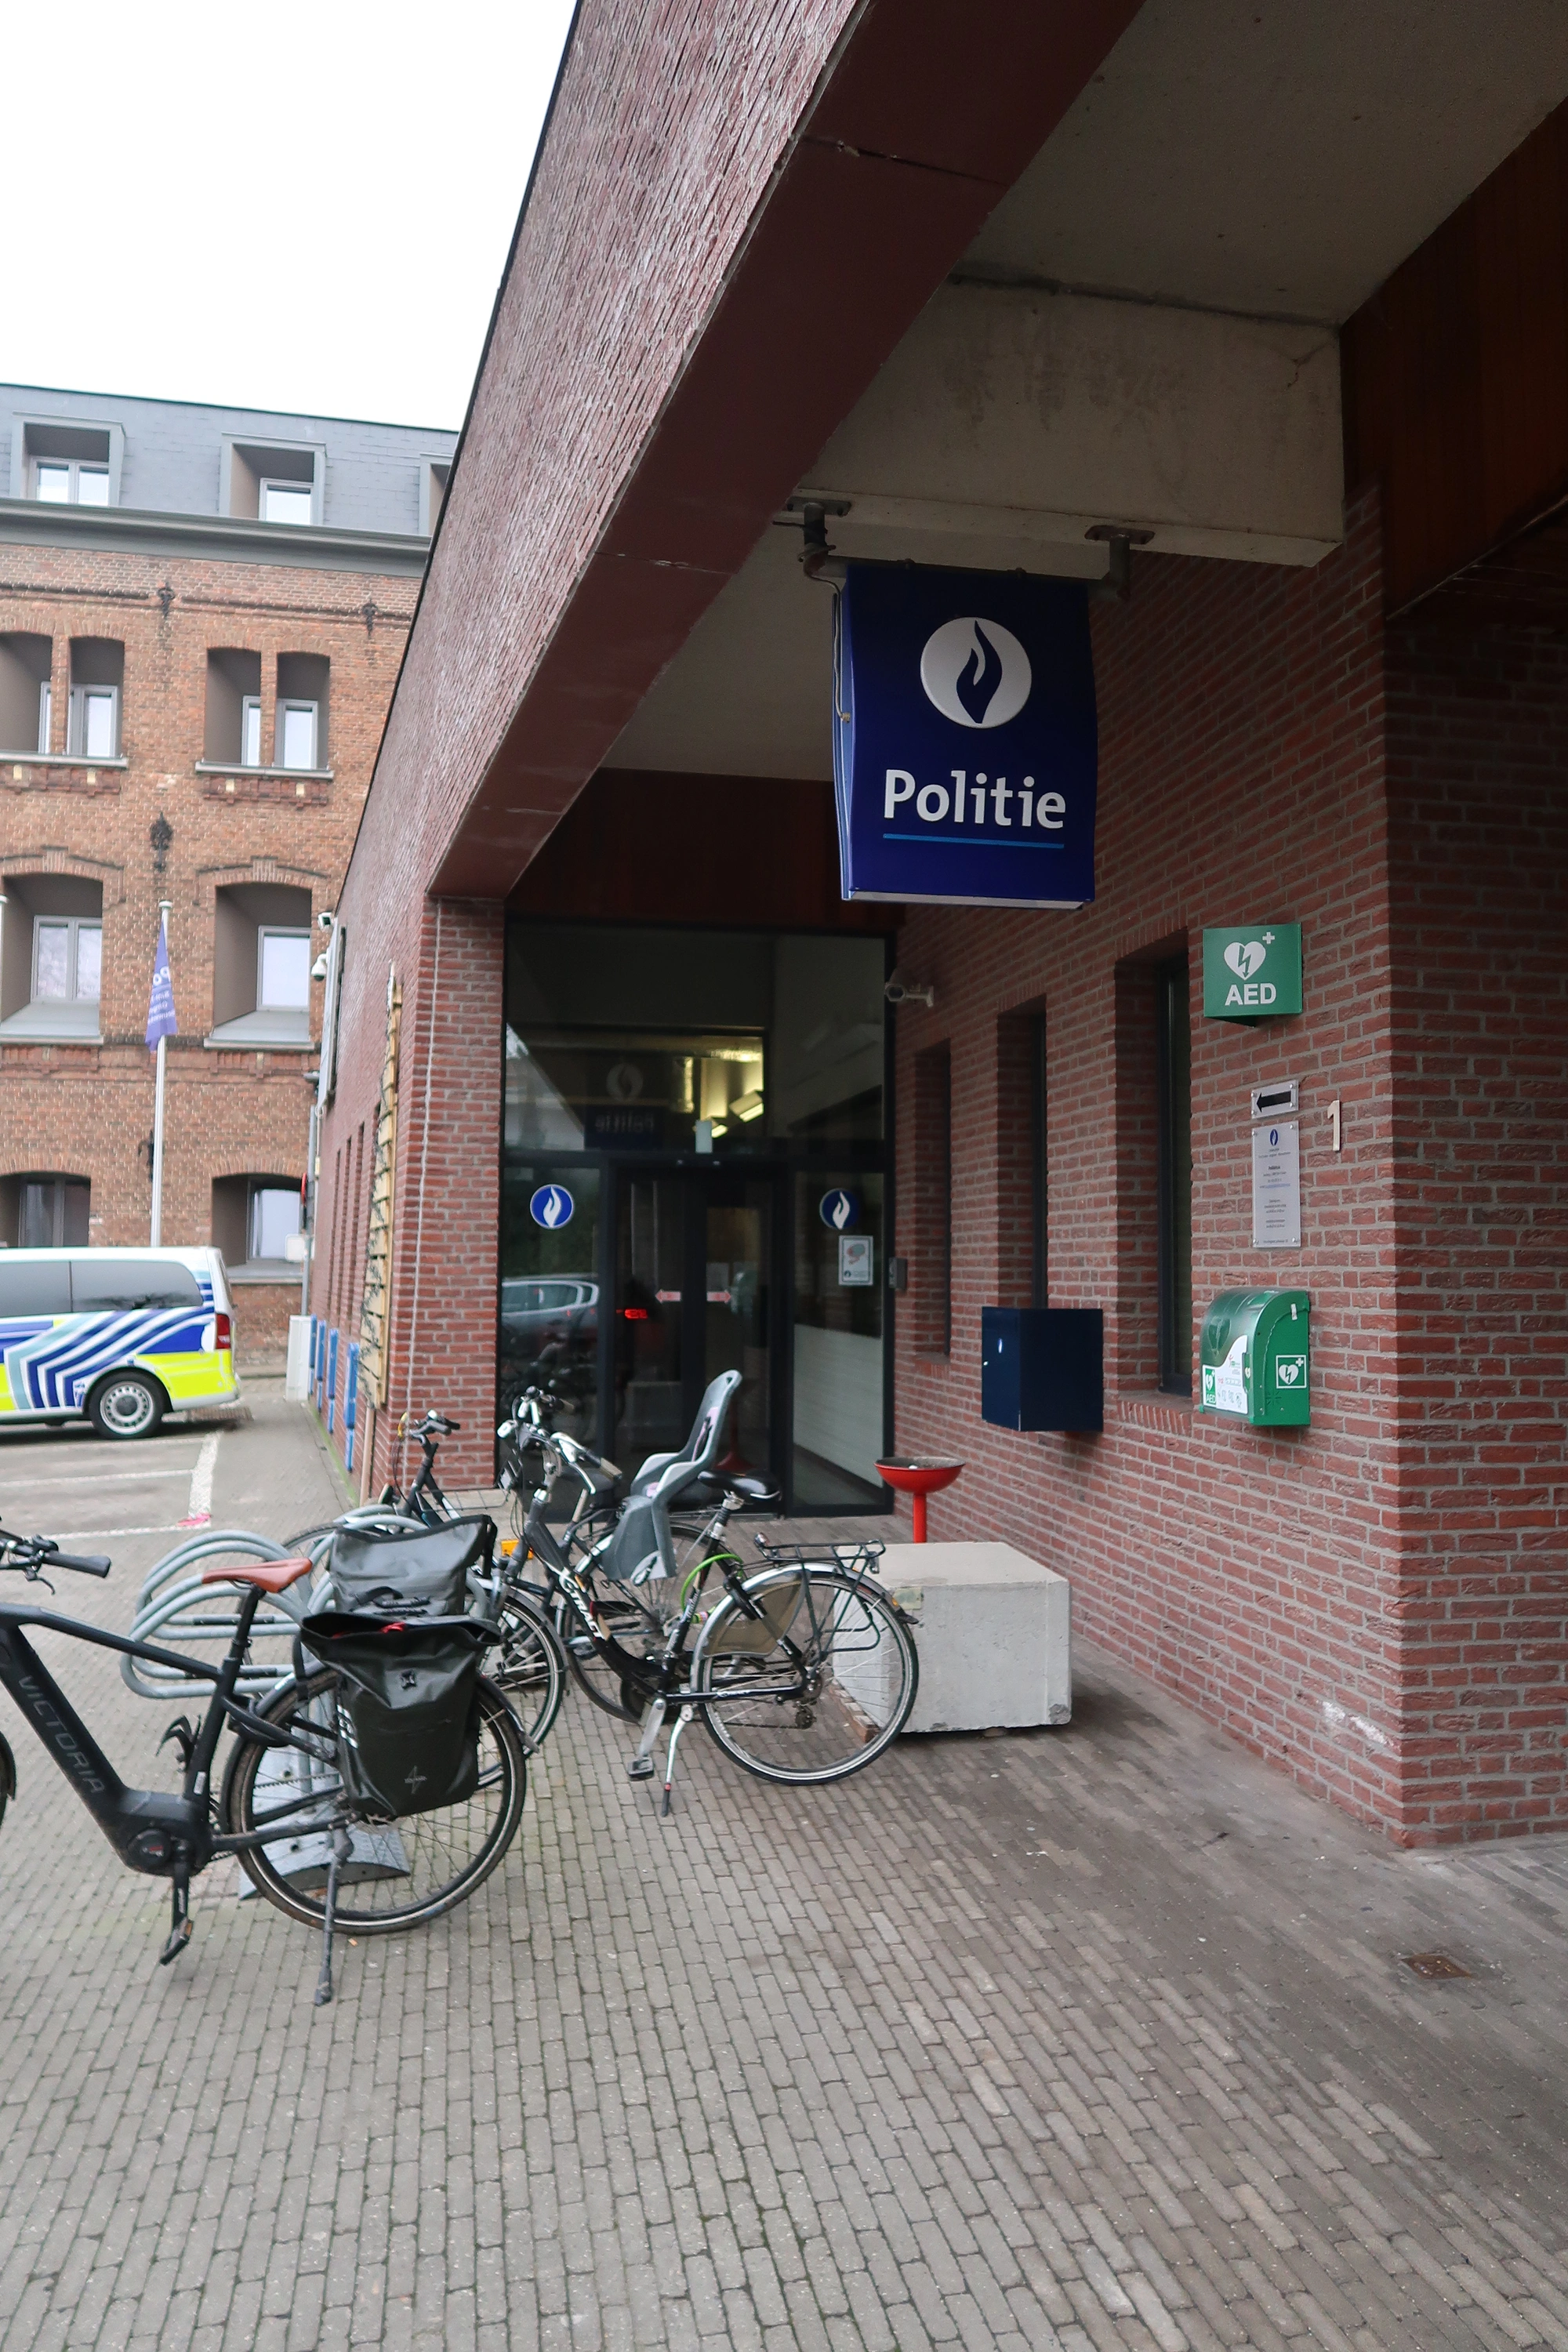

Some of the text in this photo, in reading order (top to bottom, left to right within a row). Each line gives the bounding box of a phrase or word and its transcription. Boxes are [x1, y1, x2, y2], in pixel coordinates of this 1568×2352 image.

[884, 769, 1066, 829] Politie
[1225, 982, 1276, 1006] AED
[1327, 1100, 1340, 1151] 1
[1206, 1393, 1216, 1403] AED
[19, 1675, 105, 1793] VICTORIA
